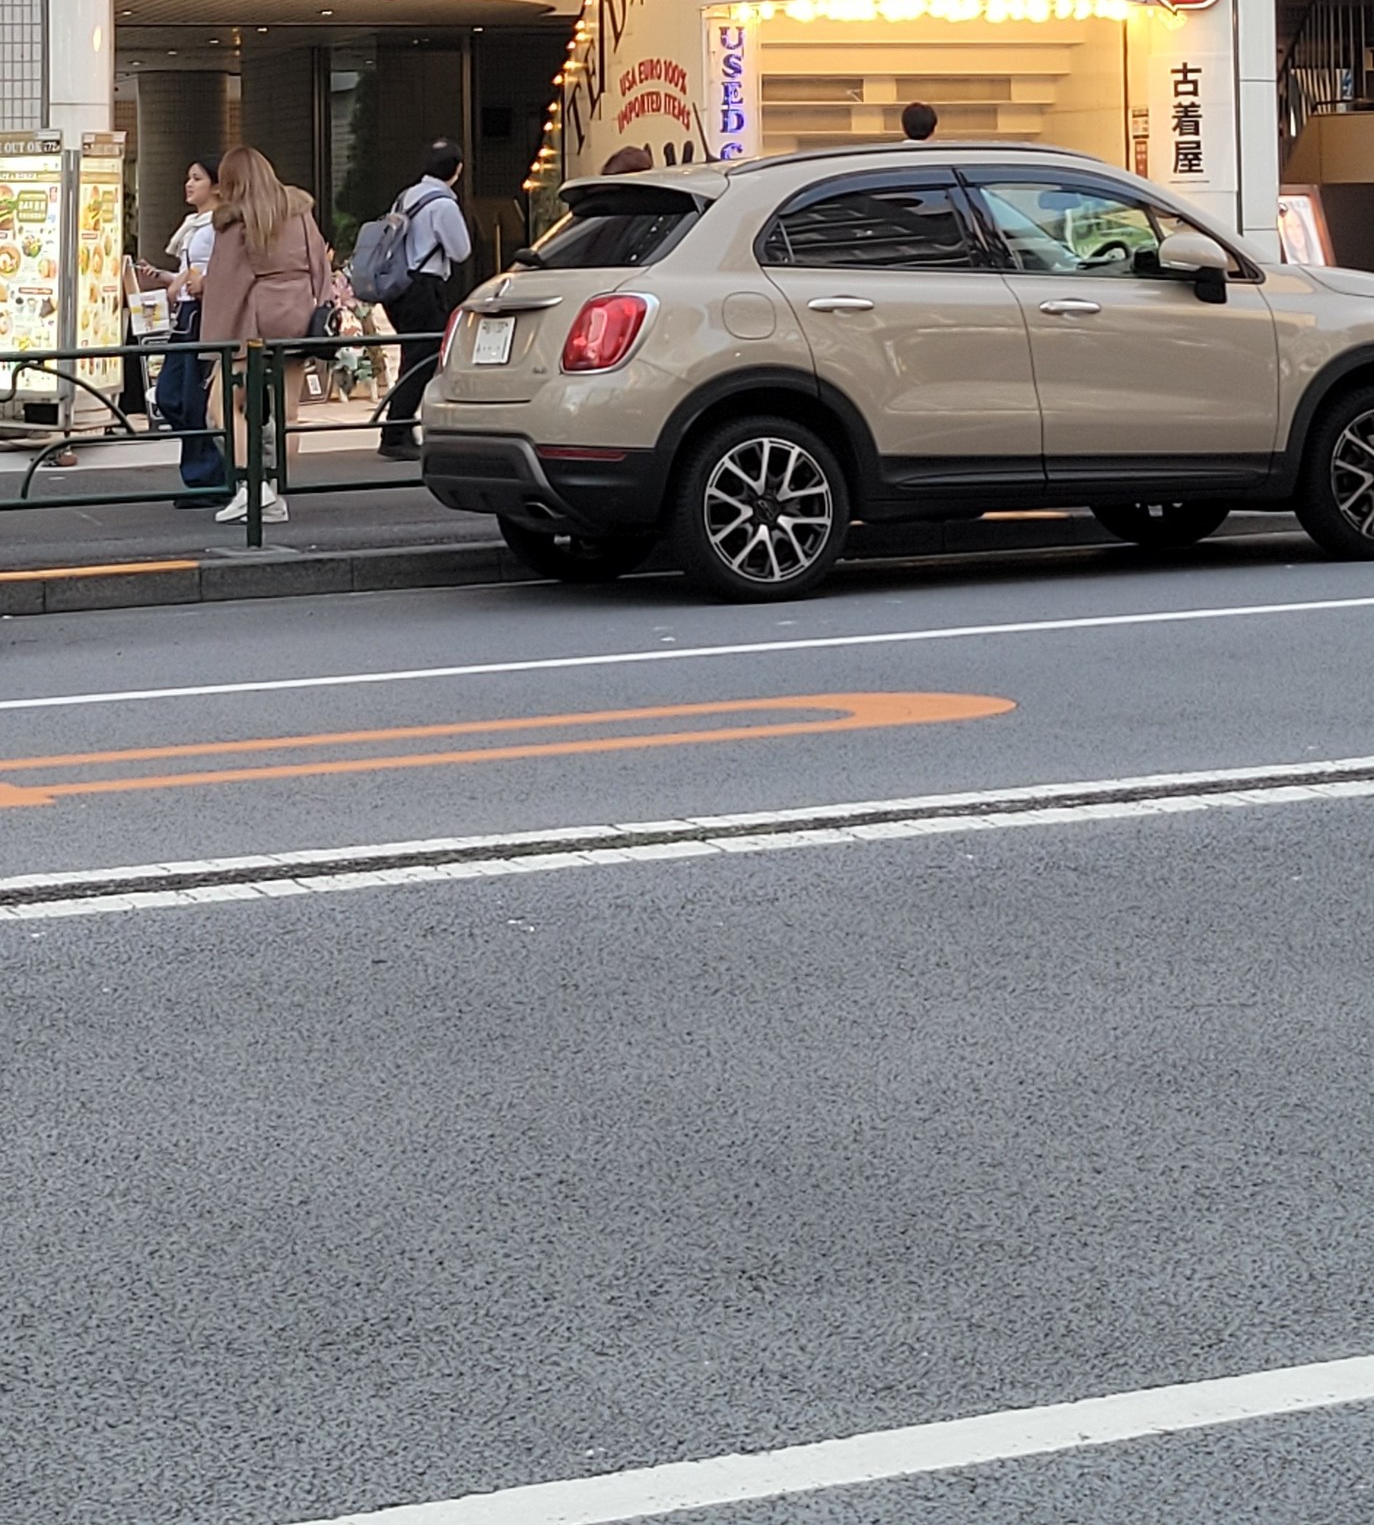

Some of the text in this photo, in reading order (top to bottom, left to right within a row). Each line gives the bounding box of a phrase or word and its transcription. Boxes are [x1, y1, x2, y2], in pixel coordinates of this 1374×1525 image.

[617, 91, 690, 134] IMPORTED ITEMS
[619, 58, 687, 97] USA EURO 100%
[719, 26, 745, 133] USED
[1170, 62, 1204, 173] 古着屋
